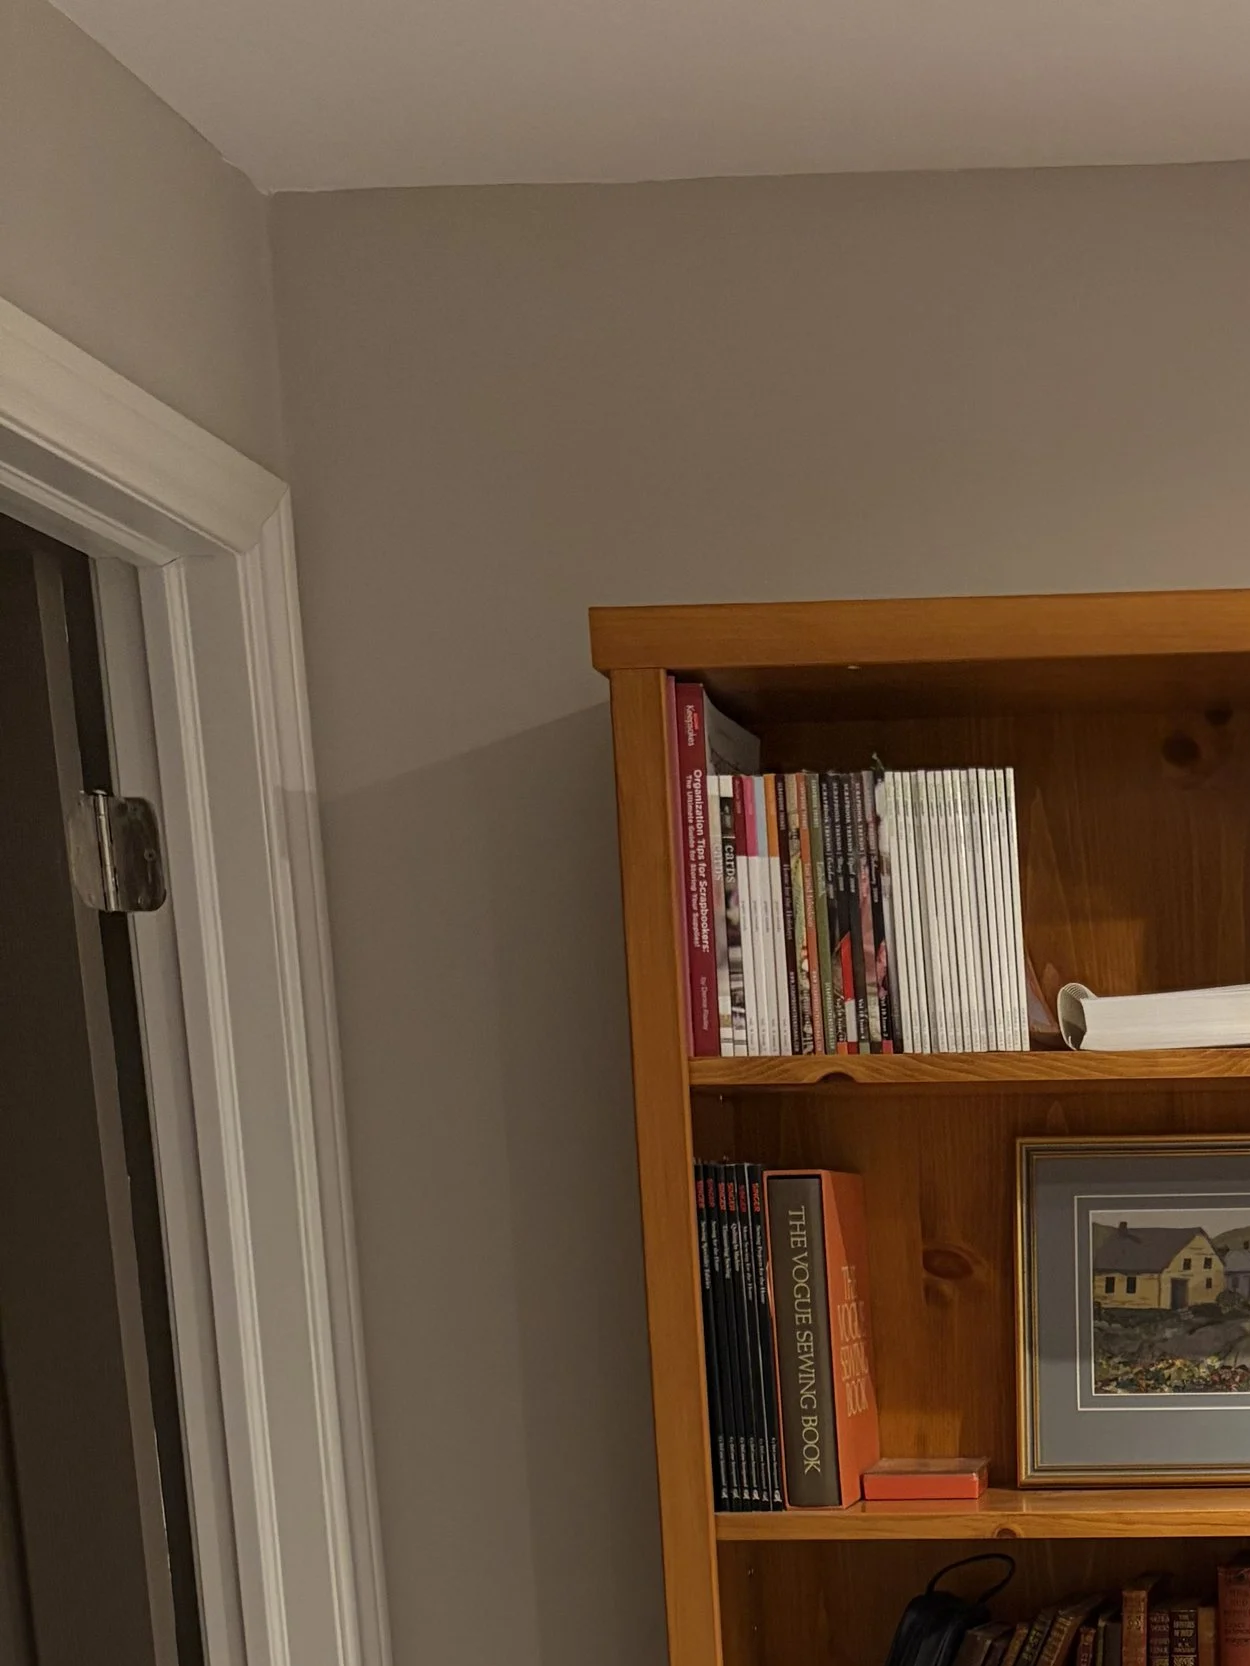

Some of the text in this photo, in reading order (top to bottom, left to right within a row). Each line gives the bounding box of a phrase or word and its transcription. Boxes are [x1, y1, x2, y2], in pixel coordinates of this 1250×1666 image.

[685, 704, 697, 746] Keepsakes
[687, 791, 695, 823] Ultimate
[688, 825, 696, 848] Guide
[689, 850, 697, 861] for
[693, 769, 710, 953] Organization Tips for Scrapbookers:
[690, 864, 698, 891] Storing
[692, 912, 701, 947] Supplies!
[788, 1206, 821, 1474] THE VOGUE SEWING BOOK
